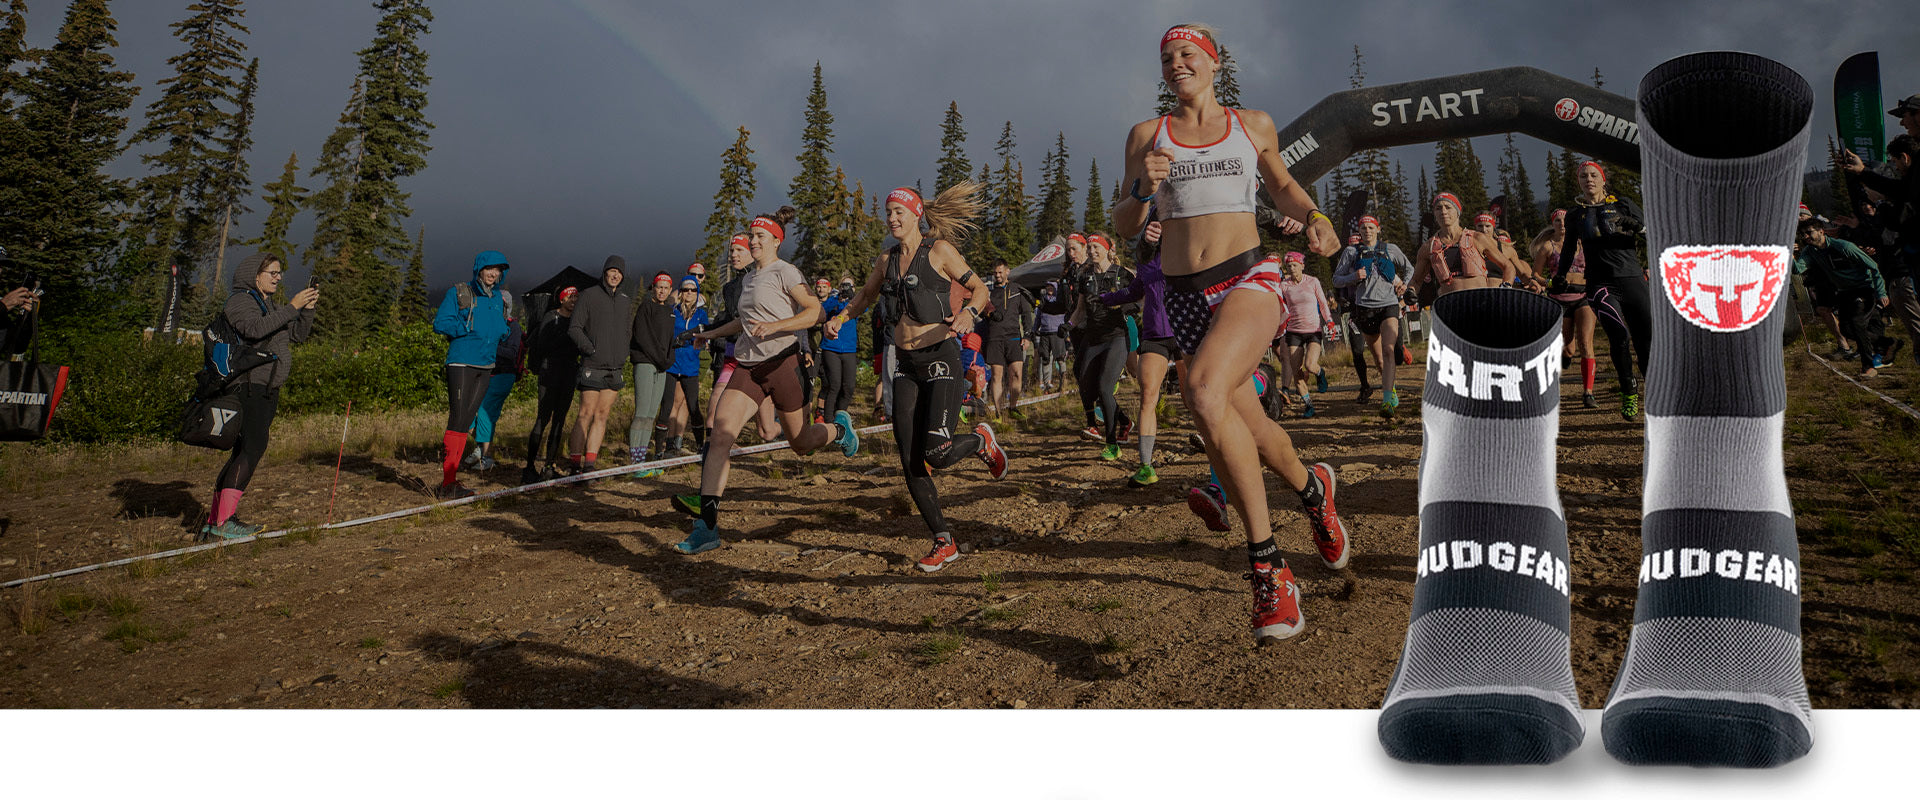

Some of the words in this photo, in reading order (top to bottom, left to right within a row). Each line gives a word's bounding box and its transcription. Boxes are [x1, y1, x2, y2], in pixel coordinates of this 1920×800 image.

[1371, 88, 1484, 127] START
[1577, 106, 1641, 146] SPART
[1169, 163, 1197, 178] GRIT
[1199, 159, 1242, 174] FITNESS
[1279, 131, 1320, 169] RTAN
[1426, 329, 1564, 402] PARTA
[1248, 544, 1277, 558] DGEAR
